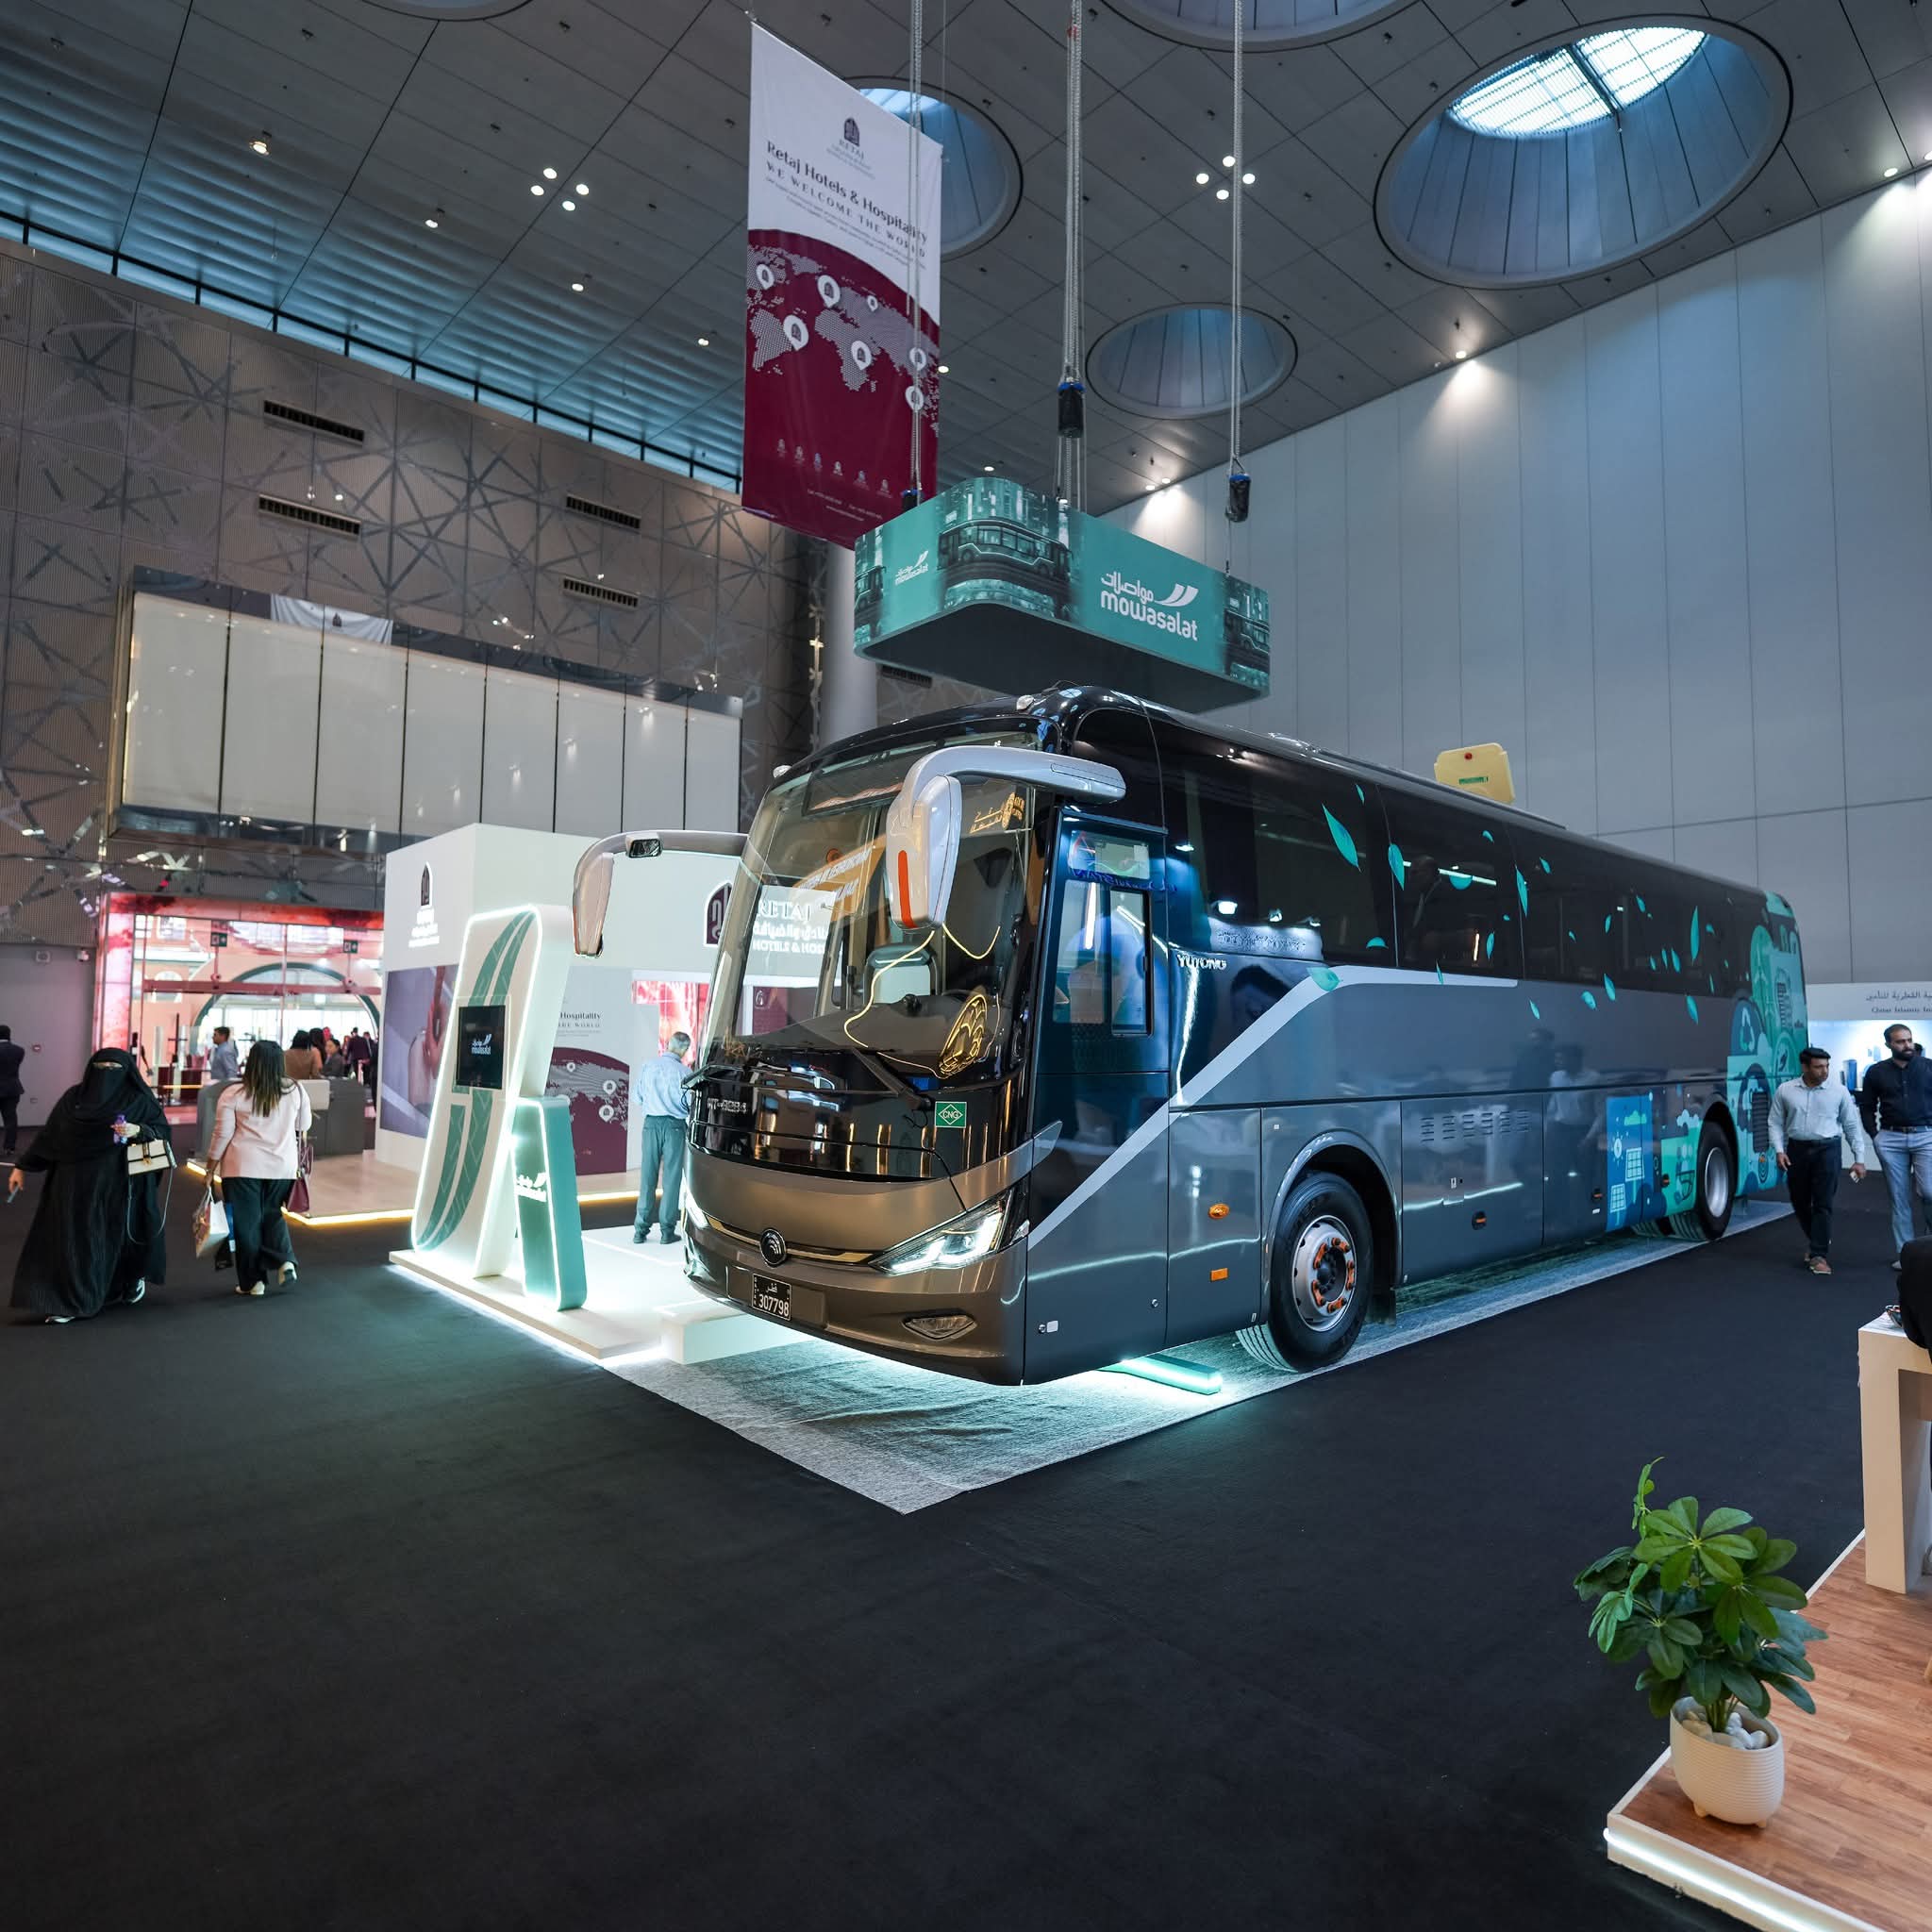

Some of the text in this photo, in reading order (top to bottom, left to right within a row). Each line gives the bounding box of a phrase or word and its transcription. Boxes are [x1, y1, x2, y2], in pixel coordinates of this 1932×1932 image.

[766, 141, 801, 175] Retaj
[805, 162, 847, 198] Hotels
[850, 190, 859, 206] &
[766, 160, 785, 179] WE
[791, 175, 853, 217] WELCOME
[859, 214, 881, 235] THE
[1101, 571, 1154, 605] مواصلات
[1101, 591, 1198, 641] mowasalat
[1176, 953, 1226, 971] YUTONG
[942, 1109, 960, 1120] CNG
[758, 1293, 790, 1317] 307798
